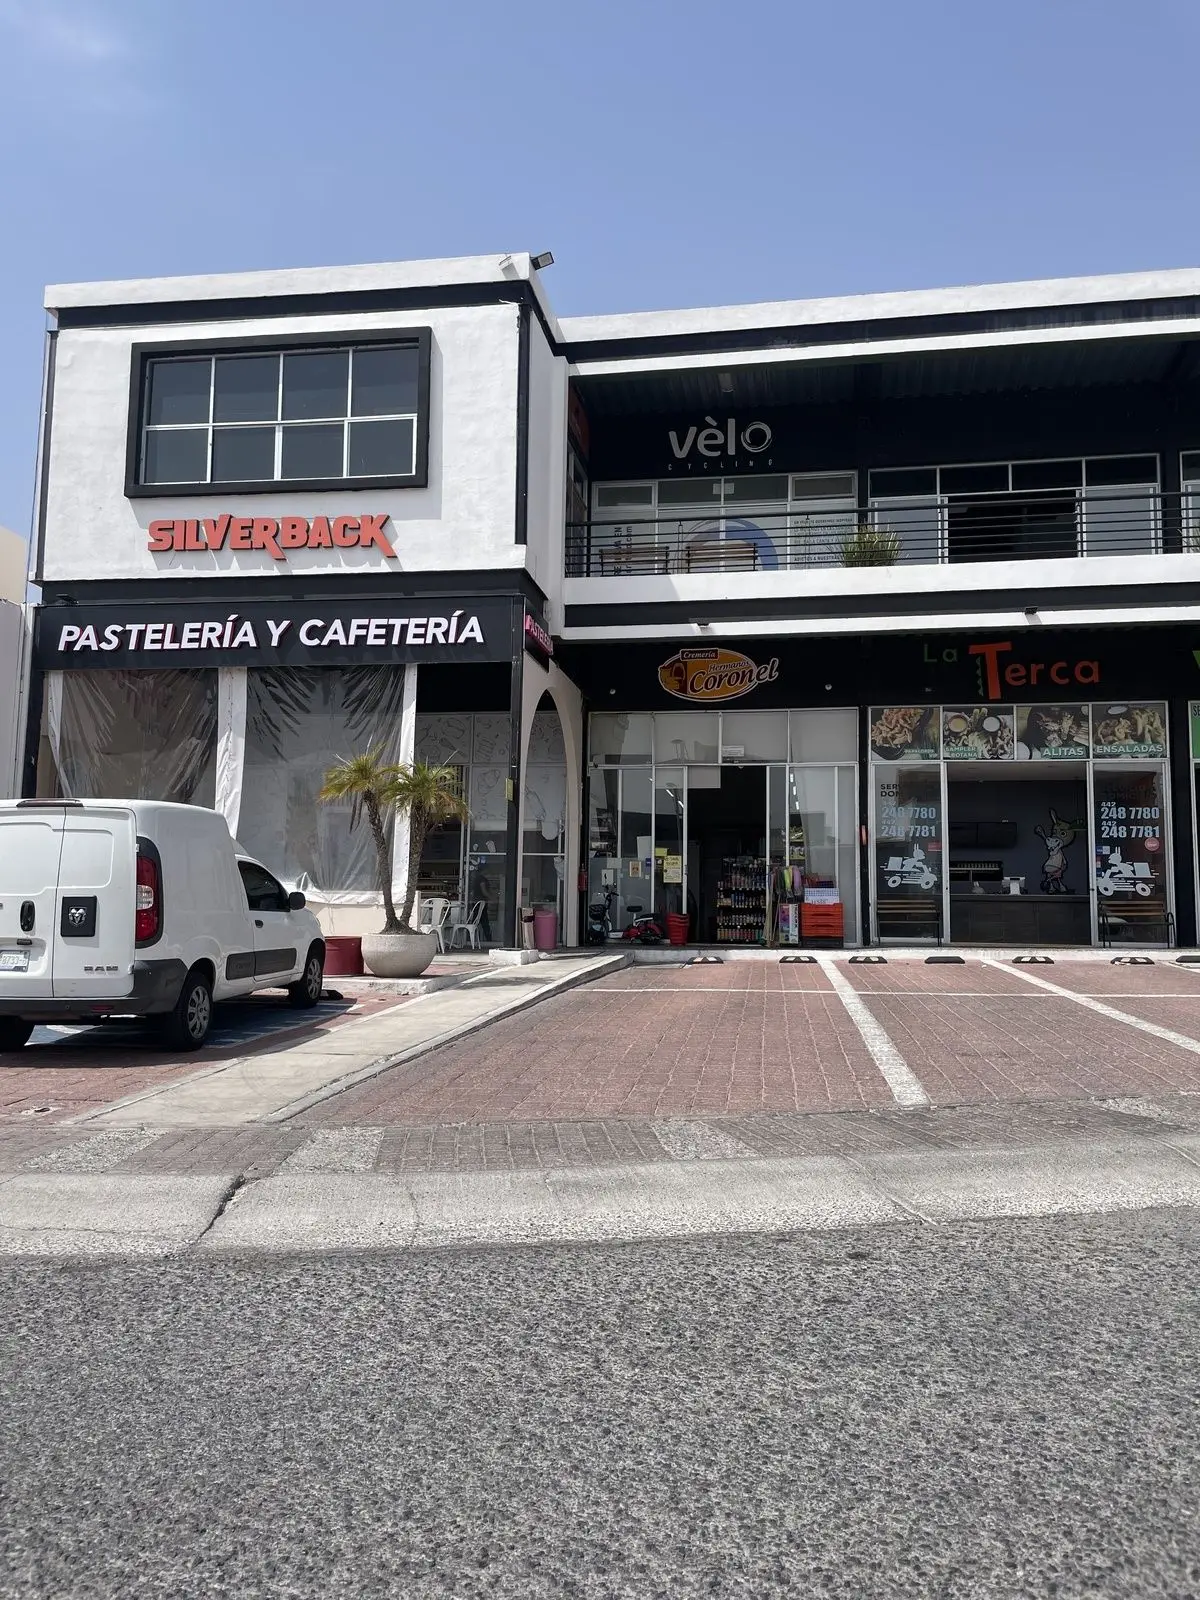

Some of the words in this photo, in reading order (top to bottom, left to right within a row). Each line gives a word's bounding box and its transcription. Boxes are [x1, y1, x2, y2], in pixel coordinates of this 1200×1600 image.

[668, 459, 773, 471] CYCLING
[148, 513, 398, 561] SILVERBACK
[57, 614, 258, 652] PASTELERÍA
[266, 620, 291, 648] Y
[299, 610, 485, 646] CAFETERÍA
[683, 651, 716, 659] Cremería
[708, 661, 749, 673] Hermanos
[923, 644, 958, 663] La
[968, 641, 1101, 700] Terca
[688, 658, 780, 694] Coronel
[1042, 747, 1085, 757] ALITAS
[1096, 744, 1163, 754] ENSALADAS
[908, 807, 937, 819] 7780
[1100, 806, 1126, 819] 248
[1129, 807, 1160, 819] 7780
[908, 825, 936, 837] 7781
[1101, 825, 1127, 838] 248
[1129, 825, 1160, 838] 7781
